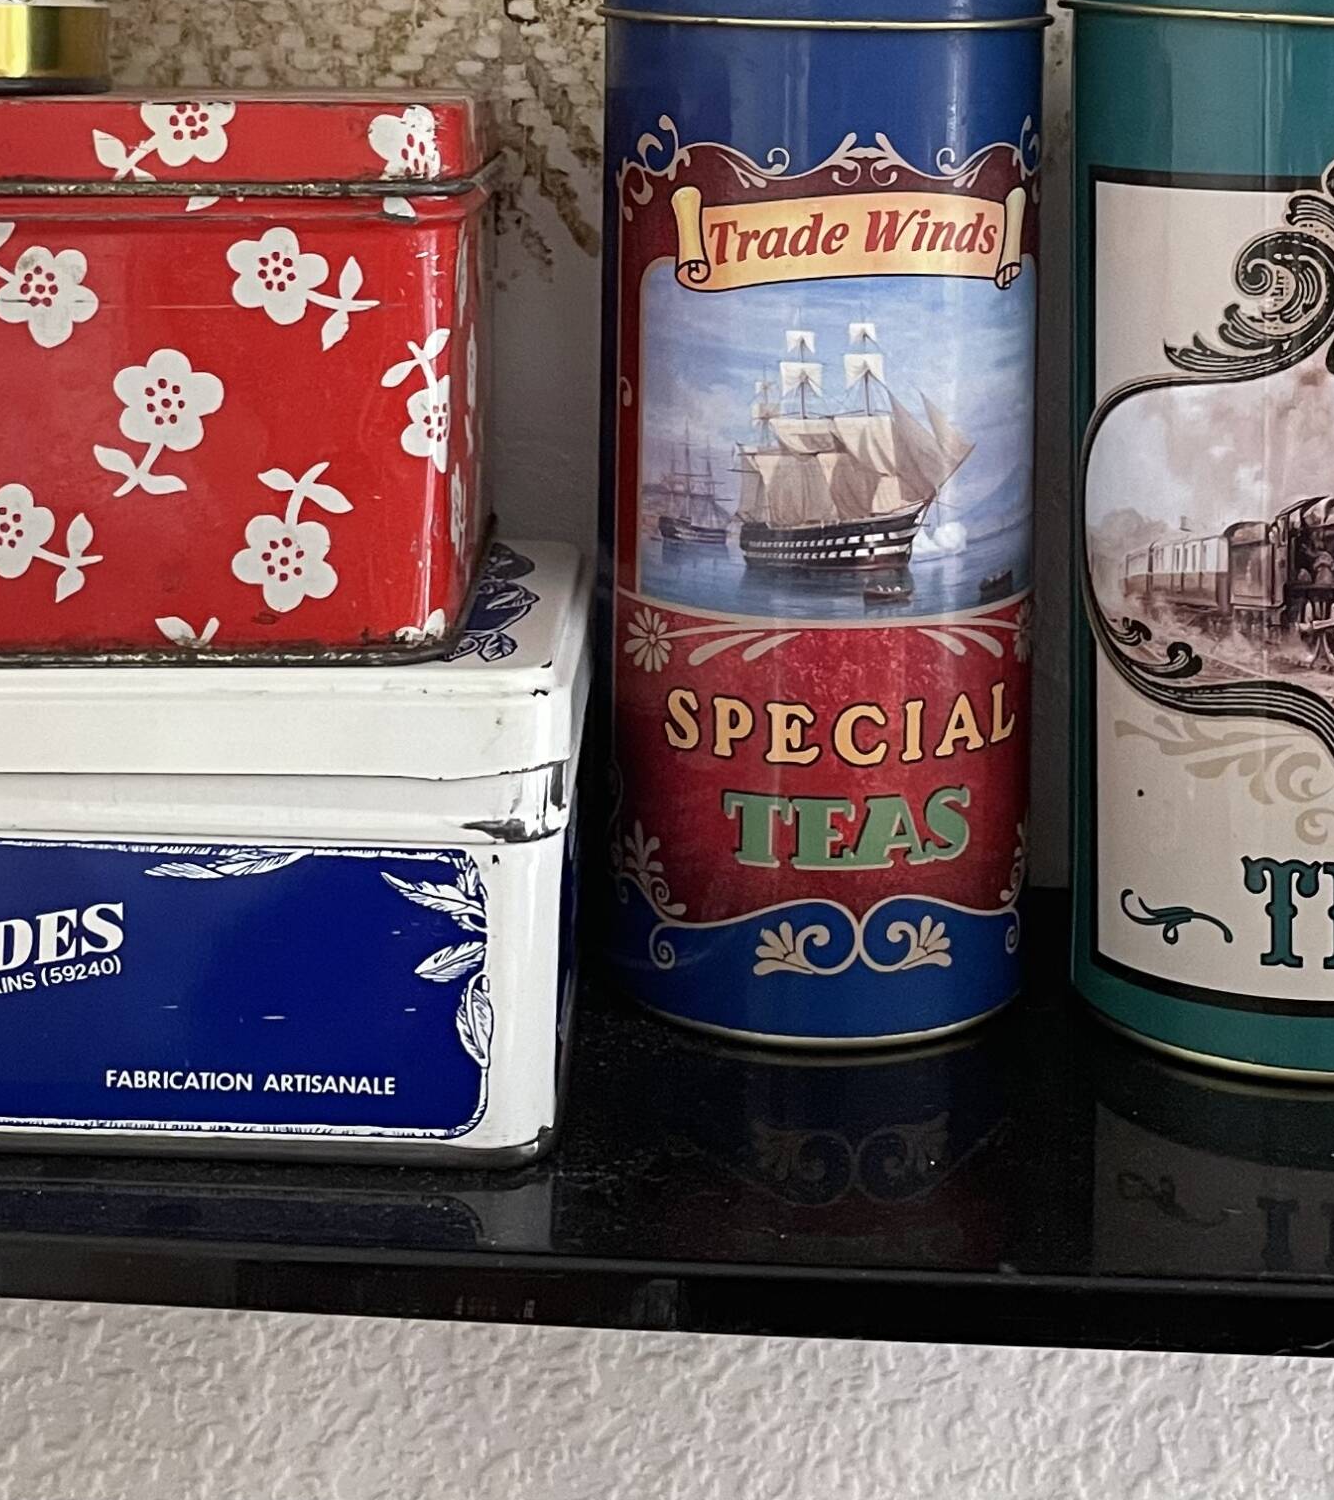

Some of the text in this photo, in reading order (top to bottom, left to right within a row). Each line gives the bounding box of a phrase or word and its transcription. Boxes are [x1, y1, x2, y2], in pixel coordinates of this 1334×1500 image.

[708, 208, 998, 266] Trade Winds
[665, 681, 1017, 766] SPECIAL
[723, 786, 972, 871] TEAS
[40, 954, 122, 988] (59240)
[105, 1069, 396, 1096] FABRICATION ARTISANALE
